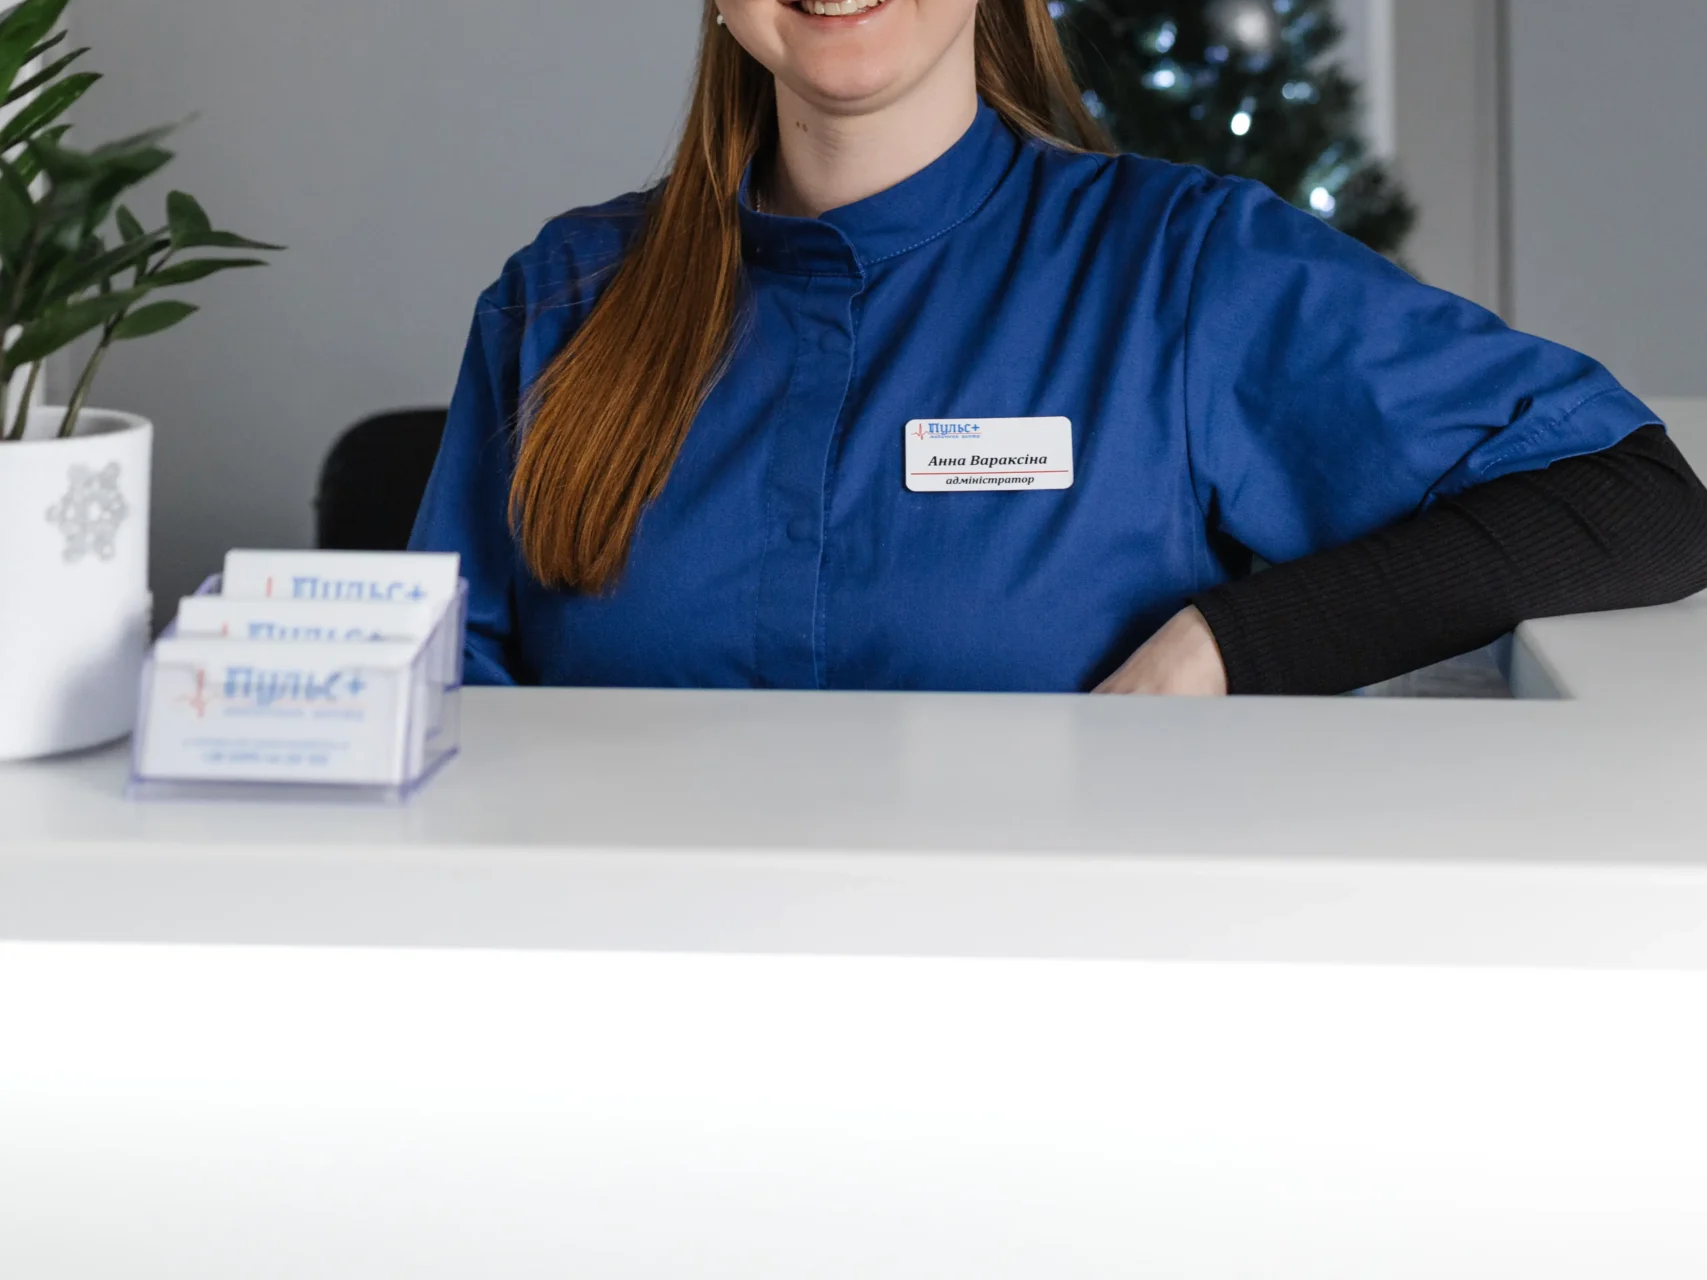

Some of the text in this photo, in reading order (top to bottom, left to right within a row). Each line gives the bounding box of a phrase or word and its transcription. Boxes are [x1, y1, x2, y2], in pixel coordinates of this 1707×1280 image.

[928, 422, 980, 435] Пульс+
[928, 454, 1048, 468] Анна Вараксіна
[945, 476, 1034, 486] адміністратор
